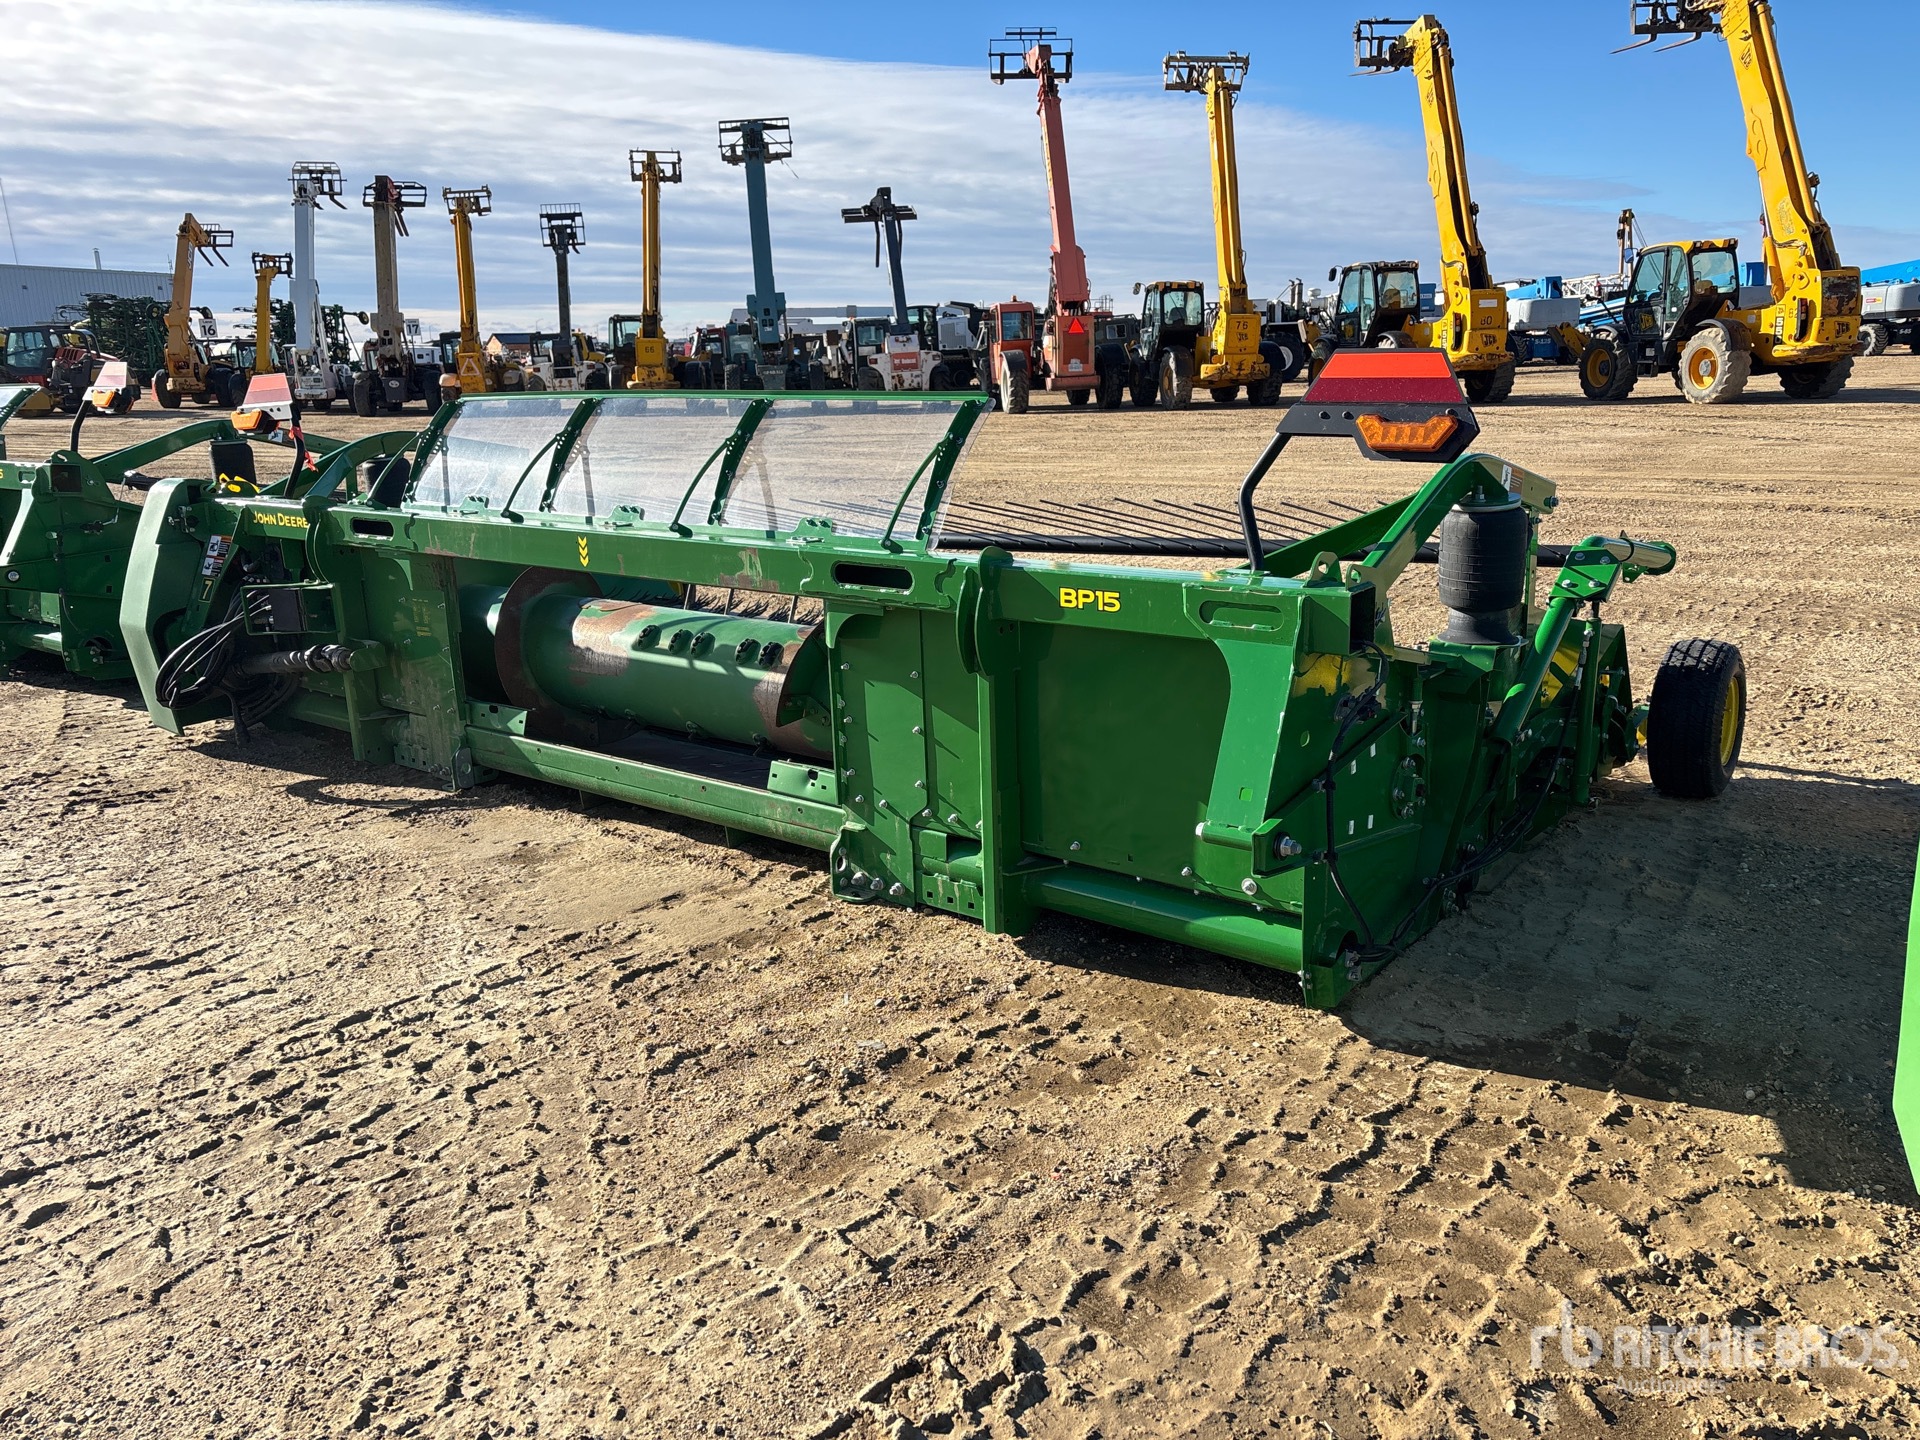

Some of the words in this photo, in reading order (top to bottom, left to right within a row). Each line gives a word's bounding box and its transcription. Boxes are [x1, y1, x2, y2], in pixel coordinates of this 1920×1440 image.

[201, 324, 217, 336] 16
[406, 324, 419, 334] 17
[1235, 321, 1249, 330] 76
[1775, 317, 1784, 345] 550
[1836, 321, 1850, 338] JCB
[644, 346, 655, 354] 66
[253, 510, 277, 526] JOHN
[277, 512, 310, 529] DEERE
[202, 580, 213, 600] 7
[1059, 587, 1121, 612] BP15
